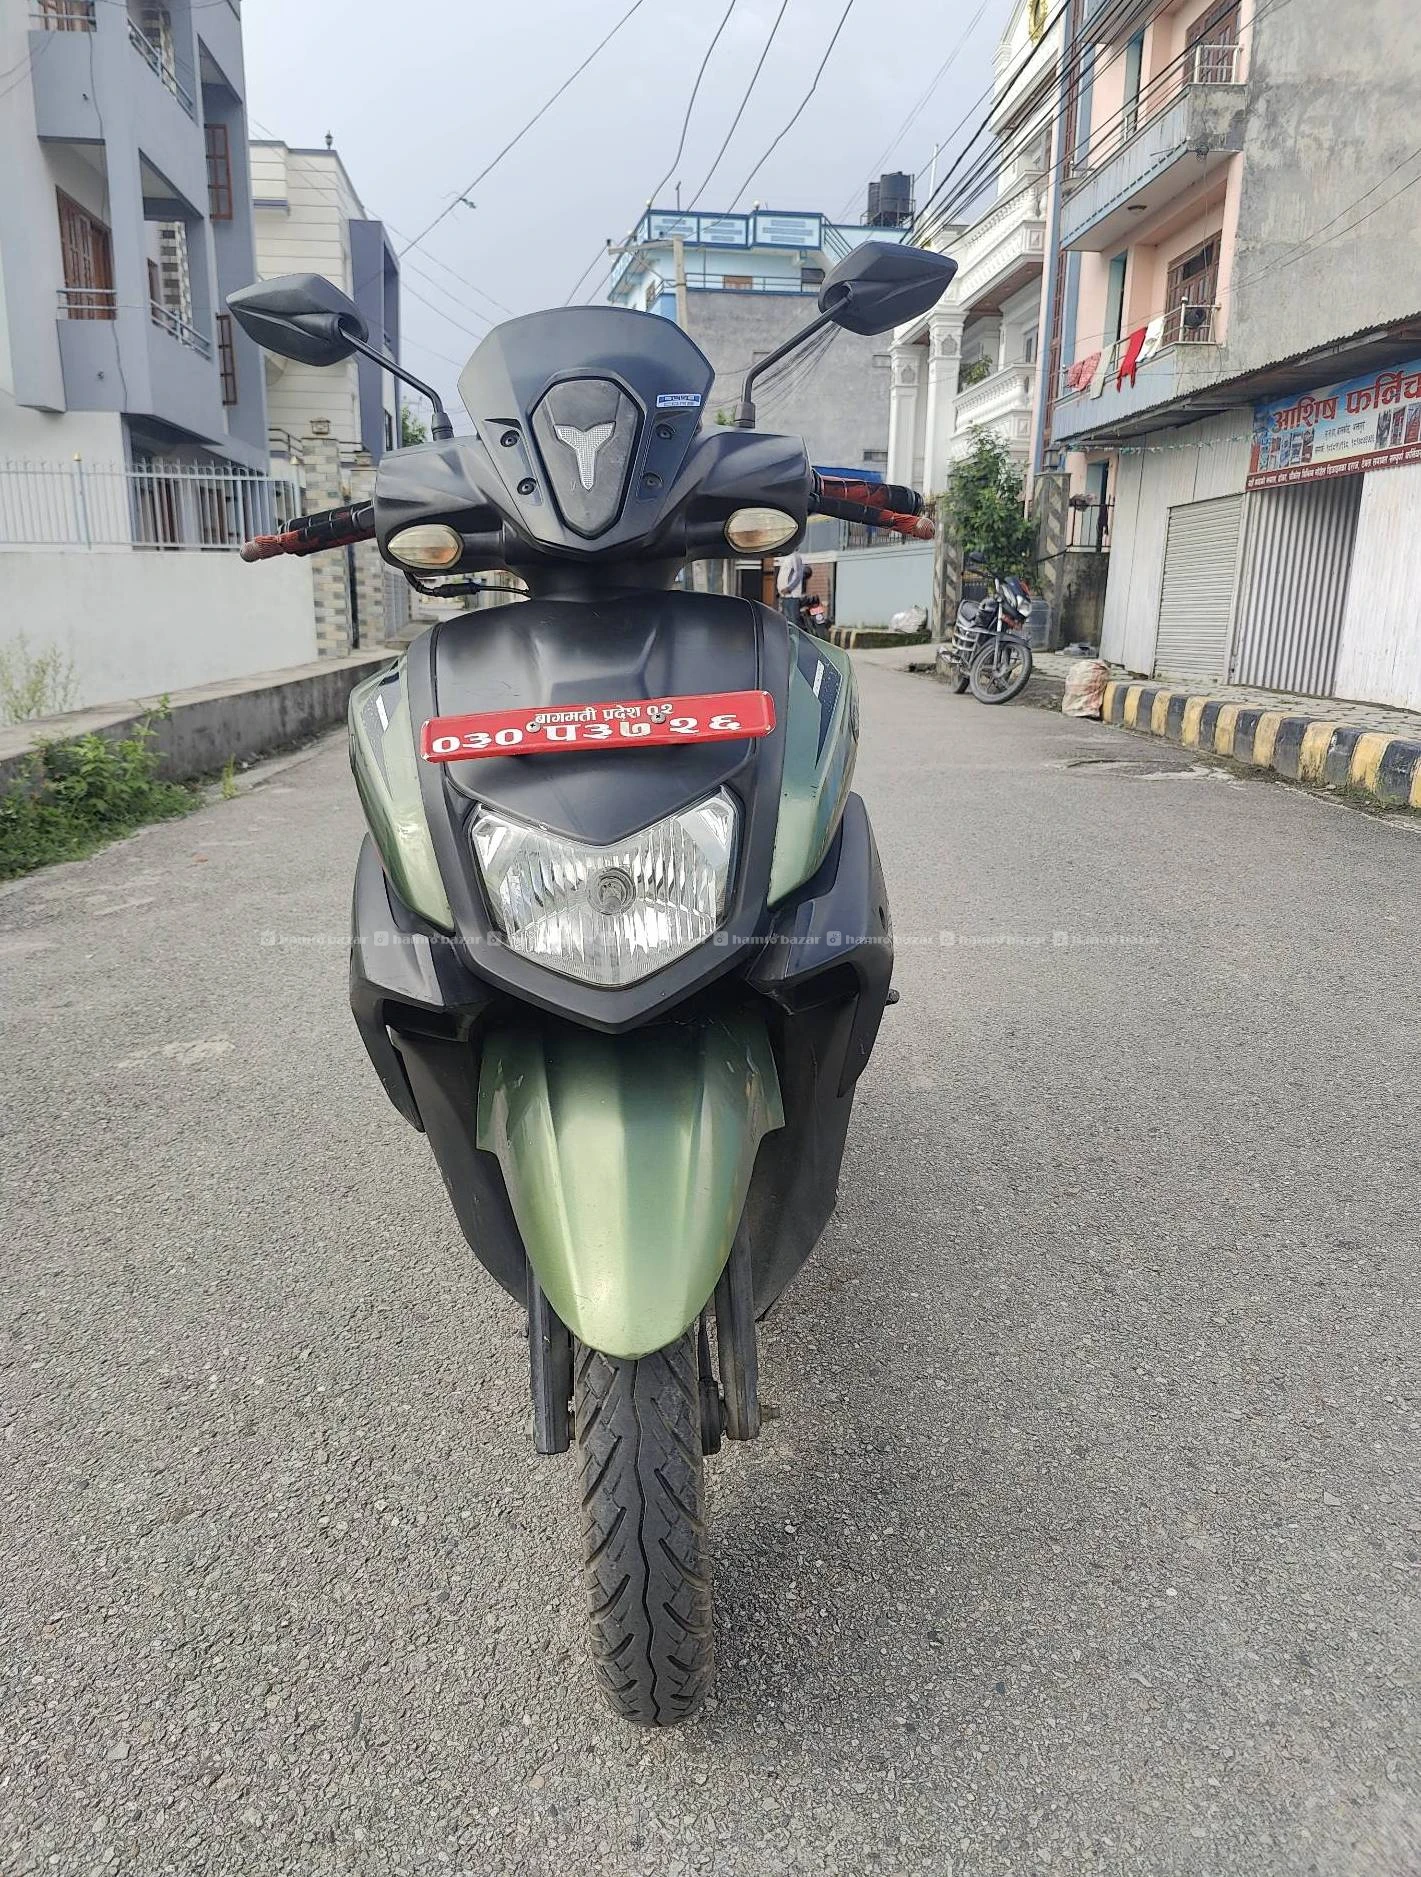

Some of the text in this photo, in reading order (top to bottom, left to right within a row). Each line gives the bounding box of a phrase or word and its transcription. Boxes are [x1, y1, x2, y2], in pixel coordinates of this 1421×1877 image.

[1271, 394, 1339, 433] आशिष
[535, 707, 597, 724] बागमती
[602, 704, 641, 721] प्रदेश
